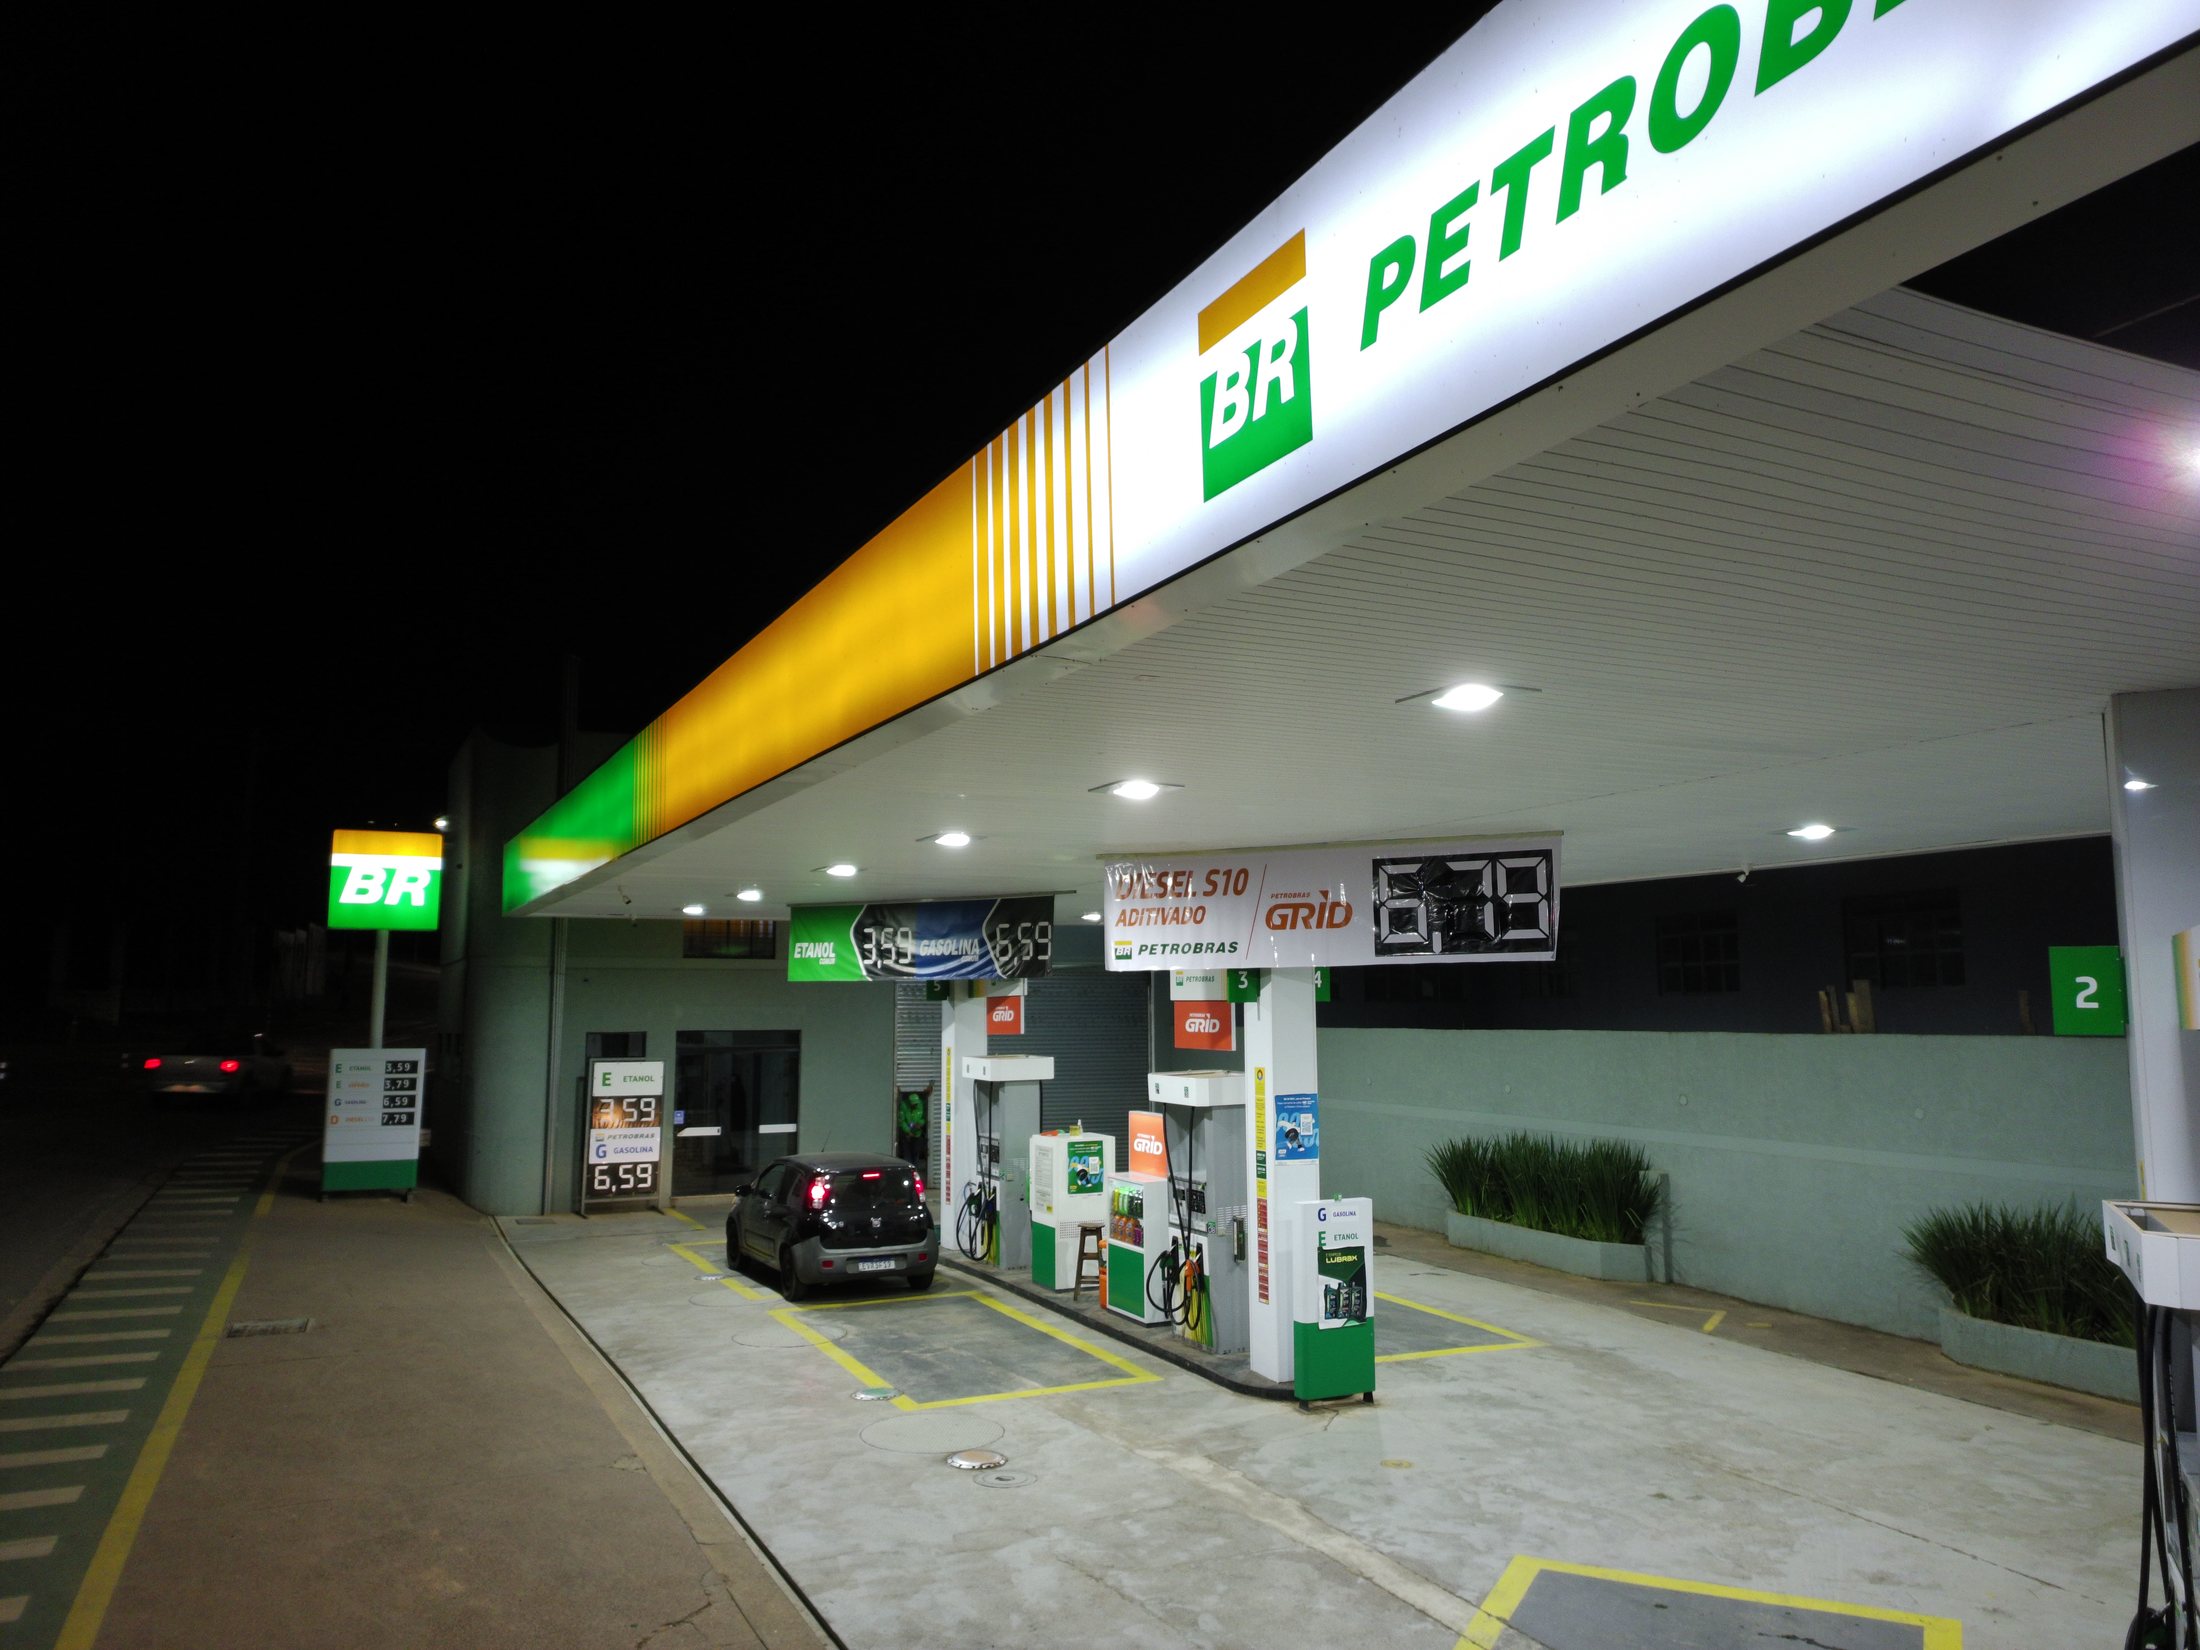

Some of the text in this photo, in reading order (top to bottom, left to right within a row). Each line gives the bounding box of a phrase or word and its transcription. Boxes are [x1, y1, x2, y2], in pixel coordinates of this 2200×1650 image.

[1360, 0, 1906, 352] PETROB
[1208, 317, 1298, 450] BR
[338, 866, 431, 907] BR
[1115, 867, 1249, 900] DIESEL S10
[1270, 891, 1311, 899] PETROBRAS
[1115, 905, 1207, 928] ADITIVADO
[1265, 889, 1353, 931] GRID
[794, 942, 836, 958] ETANOL
[863, 927, 912, 969] 3,59
[919, 938, 980, 957] GASOLINA
[996, 921, 1052, 966] 6,59
[1138, 941, 1239, 956] PETROBRAS
[1238, 970, 1249, 989] 3
[1314, 970, 1323, 988] 4
[2075, 976, 2099, 1008] 2
[992, 1006, 1015, 1022] GRID
[1184, 1013, 1220, 1033] GRID
[336, 1063, 342, 1073] E
[386, 1062, 411, 1073] 3,59
[384, 1079, 410, 1090] 3,79
[602, 1072, 655, 1087] E ETANOL
[334, 1098, 342, 1107] G
[383, 1097, 408, 1108] 6,59
[382, 1114, 407, 1125] 7,79
[595, 1144, 653, 1159] G GASOLINA
[1133, 1135, 1163, 1155] GRID
[594, 1163, 653, 1193] 6,59
[1317, 1207, 1327, 1222] G
[1318, 1230, 1359, 1247] E ETANOL
[1325, 1255, 1358, 1264] LUBRAX
